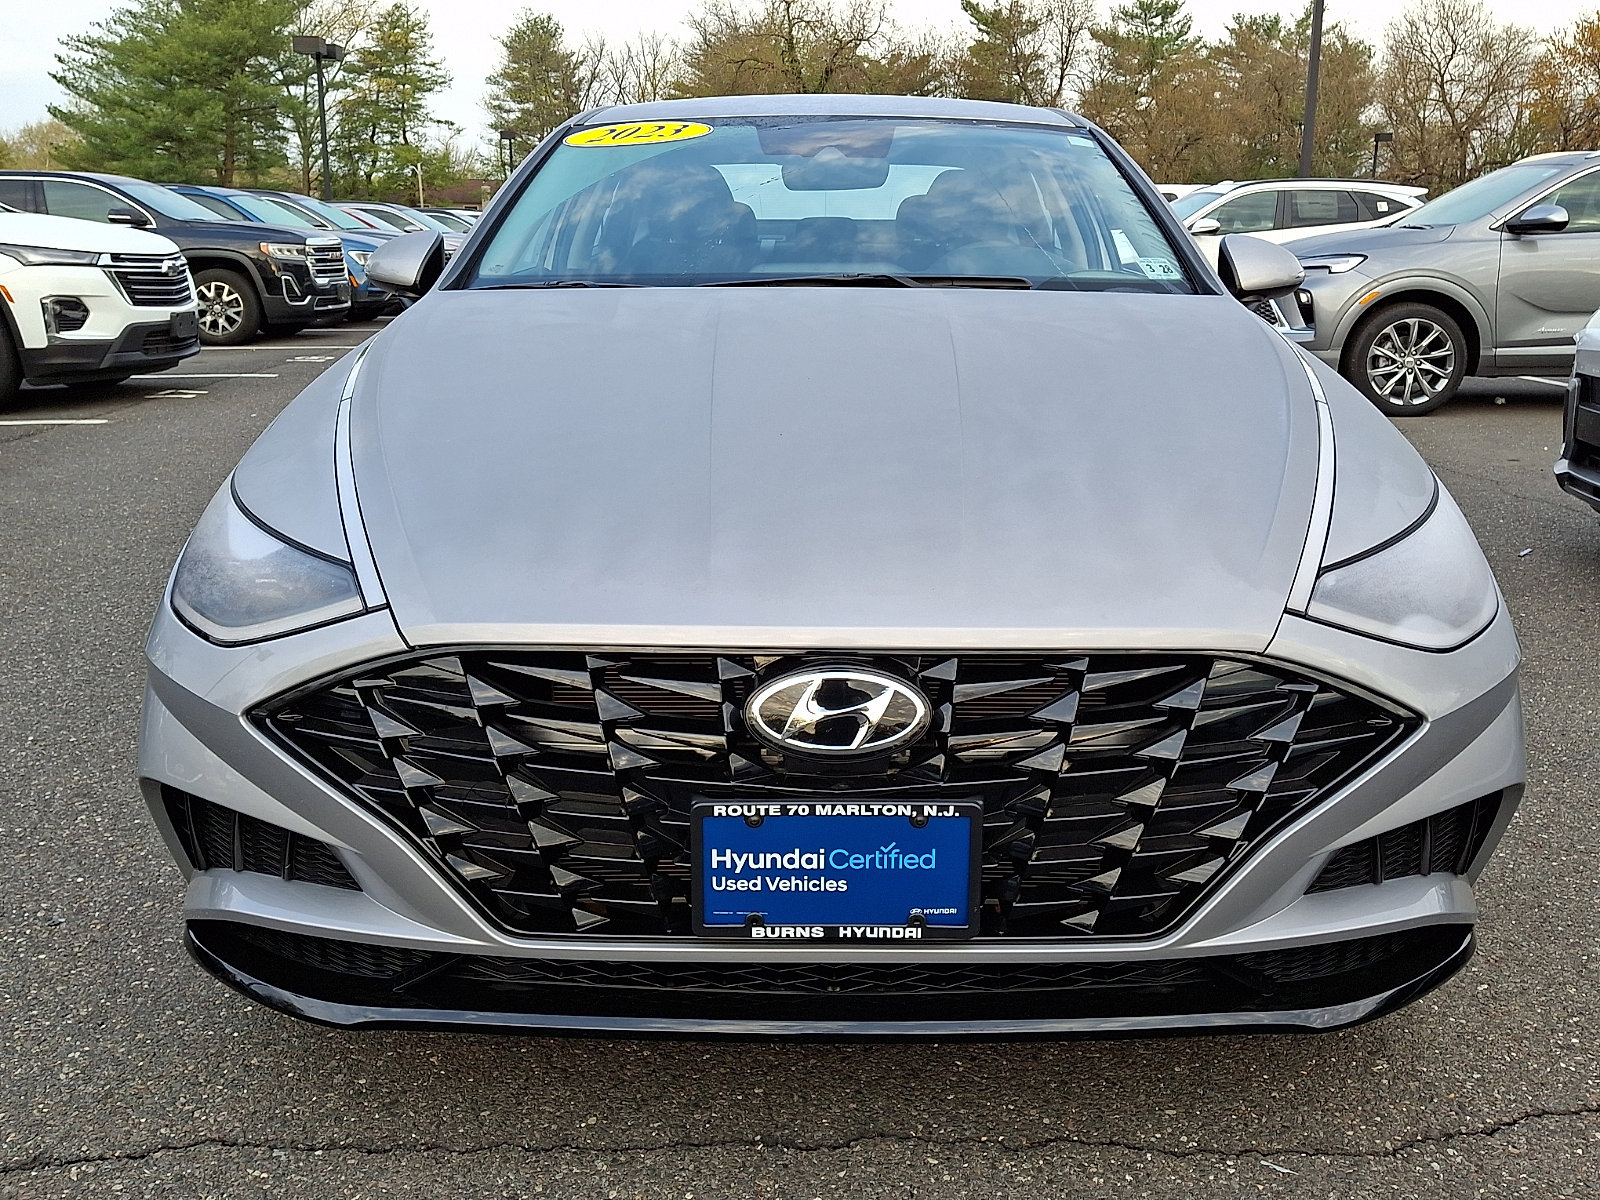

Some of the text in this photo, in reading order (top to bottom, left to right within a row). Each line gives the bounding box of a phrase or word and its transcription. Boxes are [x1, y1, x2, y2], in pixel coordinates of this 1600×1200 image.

[584, 124, 690, 143] 2023
[713, 804, 961, 818] ROUTE 70 MARLTON, N.J.
[711, 841, 937, 874] Hyundai Certified
[711, 876, 848, 892] Used Vehicles
[751, 926, 922, 939] BURNS HYUNDAI
